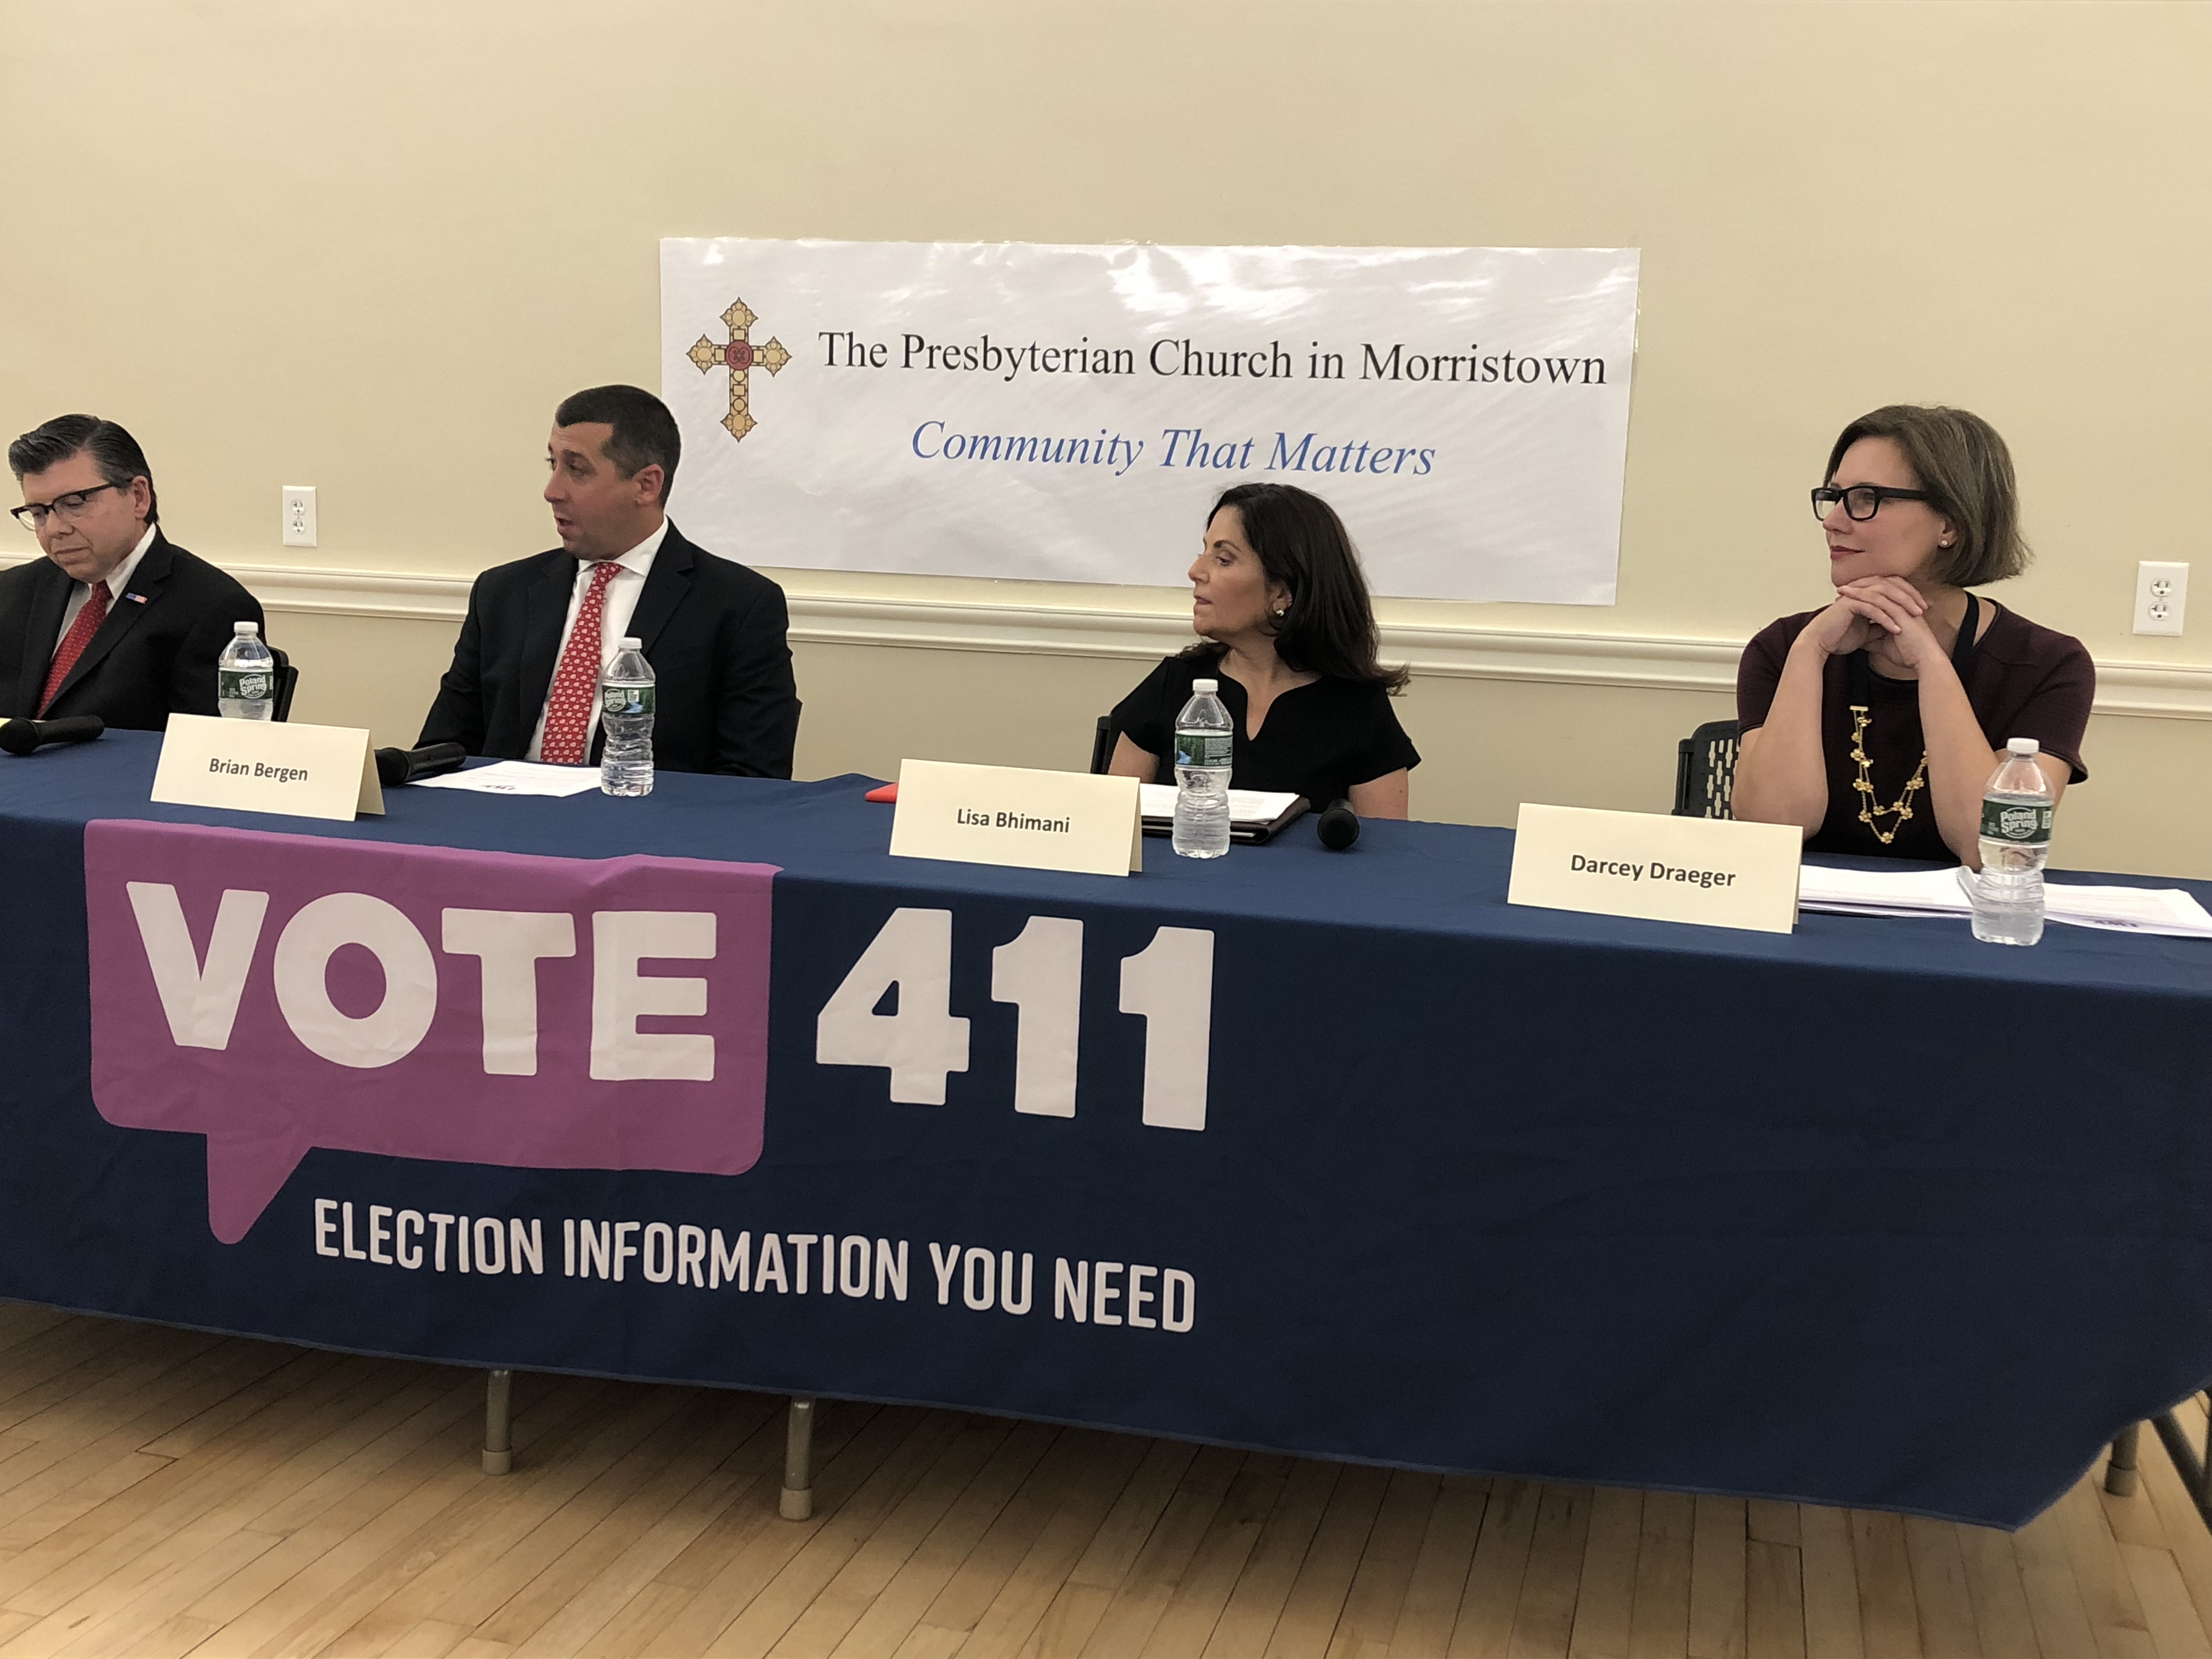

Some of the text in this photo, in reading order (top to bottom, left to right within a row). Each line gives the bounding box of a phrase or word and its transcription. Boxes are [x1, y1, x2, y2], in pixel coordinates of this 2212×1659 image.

[819, 331, 1607, 384] The Presbyterian Church in Morristown
[912, 420, 1436, 476] Community That Matters
[239, 674, 266, 687] Poland
[241, 683, 267, 696] Spring
[209, 758, 308, 783] Brian Bergen
[957, 808, 1070, 833] Lisa Bhimani
[2000, 808, 2037, 823] Poland
[2001, 820, 2038, 833] Spring
[1571, 854, 1736, 889] Darcey Draeger
[126, 881, 1215, 1131] VOTE 411
[314, 1198, 1196, 1333] ELECTION INFORMATION YOU NEED
